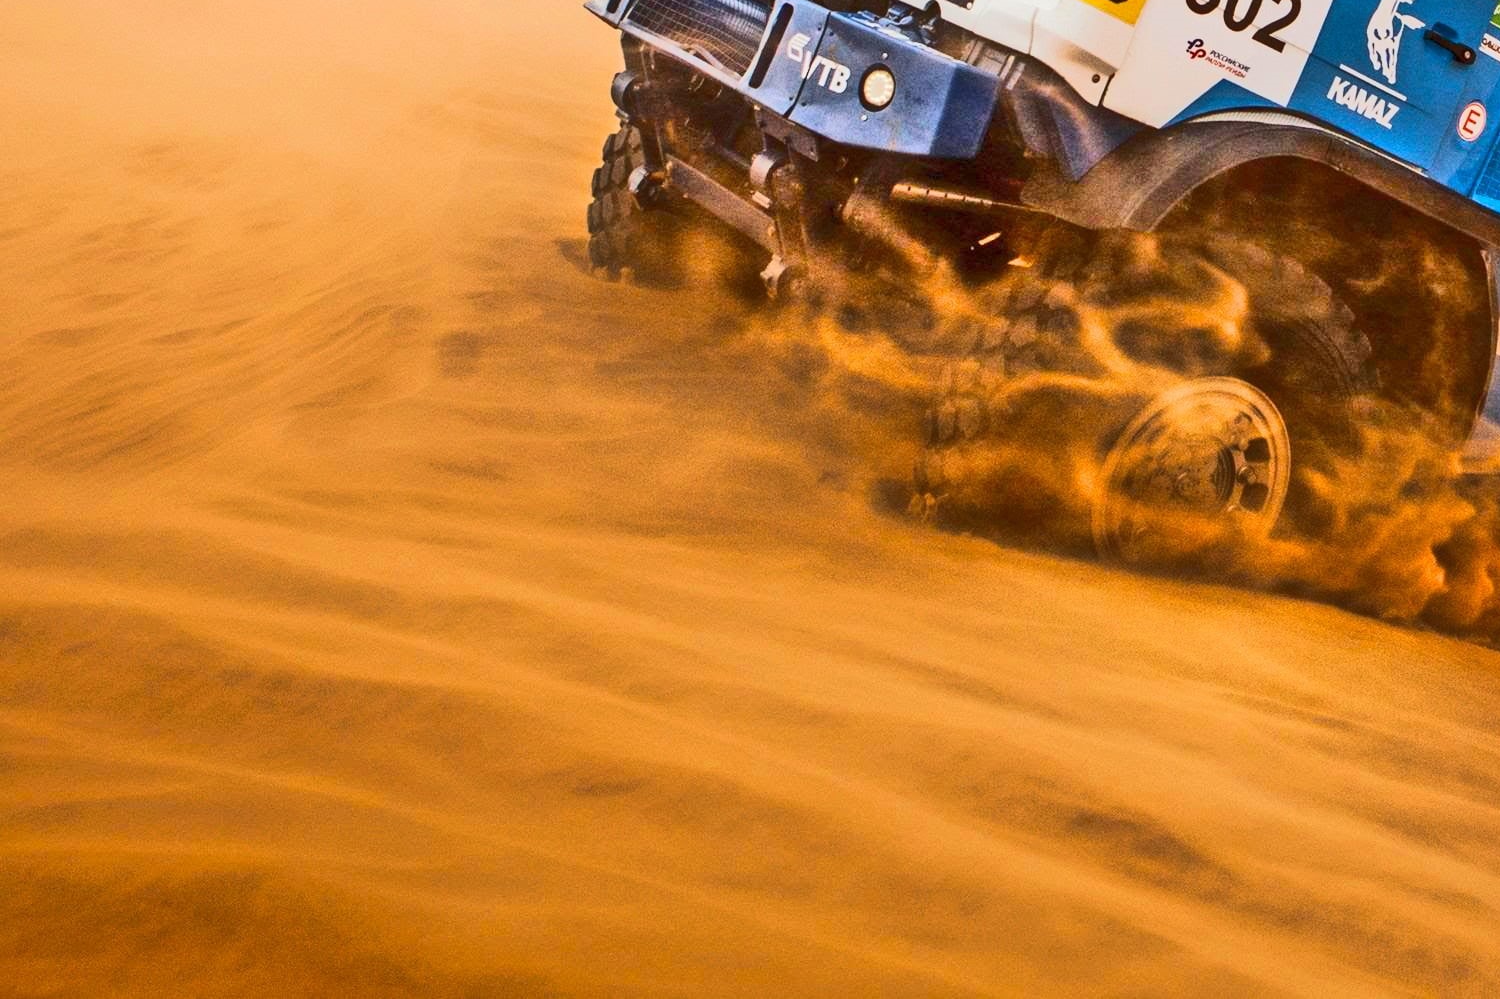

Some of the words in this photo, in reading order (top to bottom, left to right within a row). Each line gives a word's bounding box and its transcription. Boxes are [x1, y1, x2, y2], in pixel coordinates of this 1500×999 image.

[801, 50, 851, 94] VTB
[1326, 75, 1400, 130] KAMAZ
[1462, 109, 1481, 136] E
